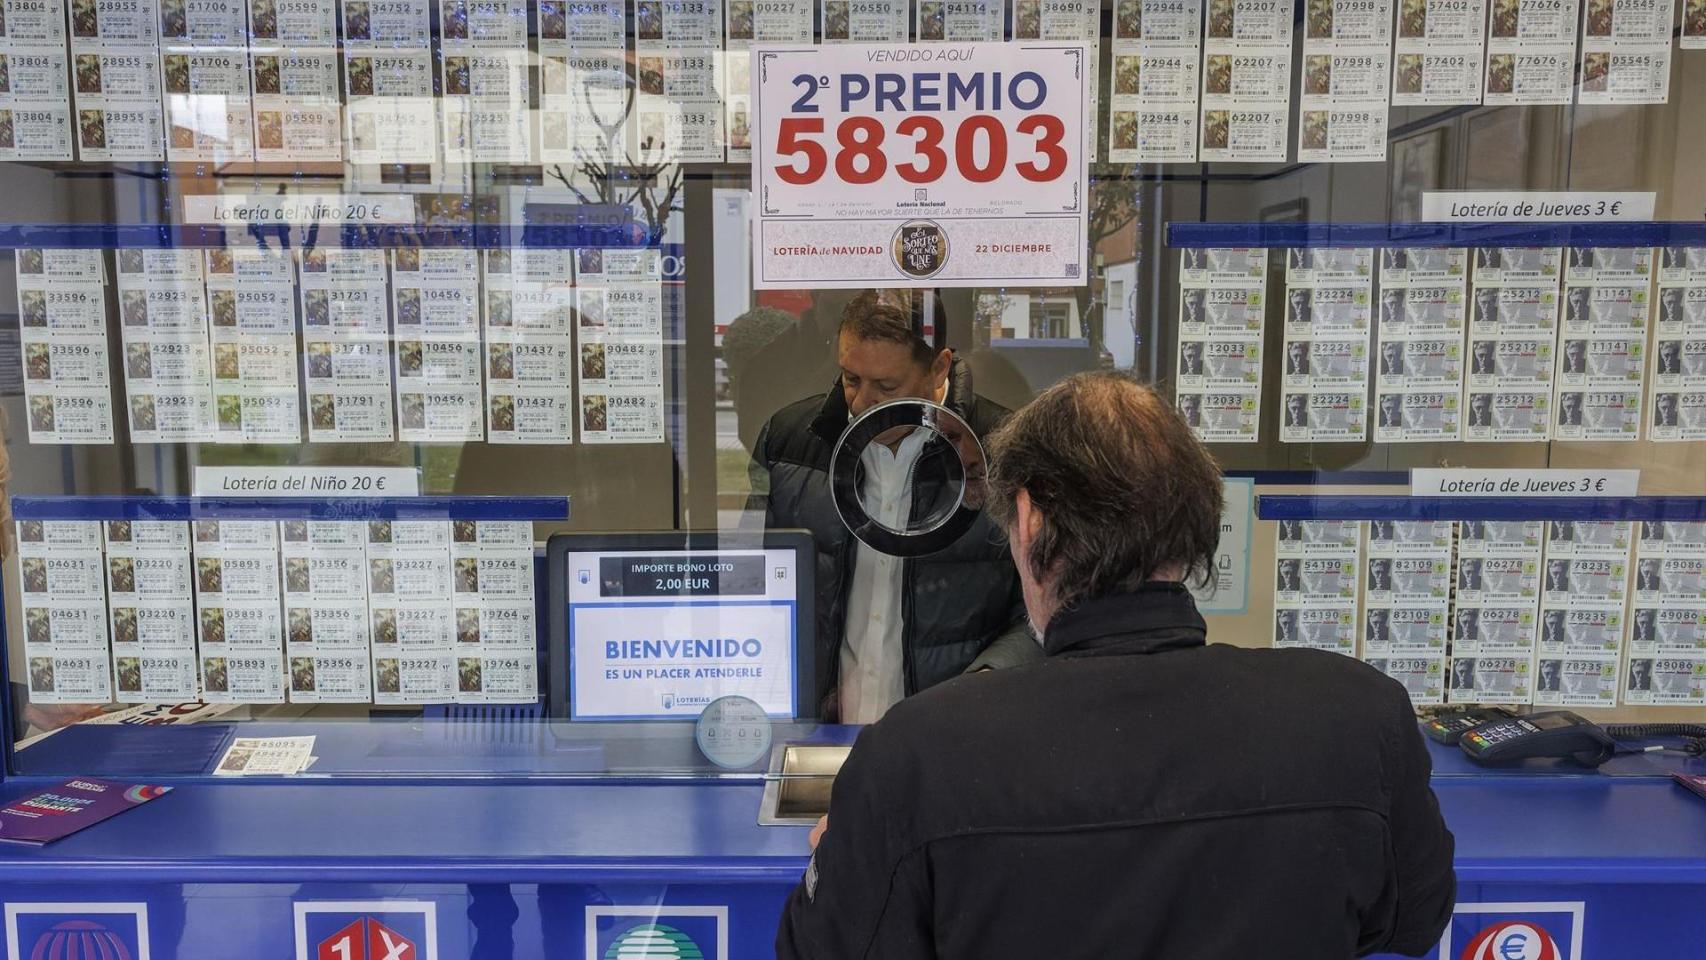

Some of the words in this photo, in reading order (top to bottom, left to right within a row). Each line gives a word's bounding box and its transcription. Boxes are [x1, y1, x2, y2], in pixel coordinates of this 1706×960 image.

[7, 1, 45, 12] 13804
[100, 1, 138, 11] 28955
[188, 2, 226, 12] 41706
[280, 2, 318, 12] 05599
[372, 3, 411, 13] 34752
[756, 3, 795, 13] 00227
[1145, 2, 1184, 10] 22944
[1237, 2, 1276, 10] 62207
[1336, 2, 1374, 10] 07998
[1428, 1, 1468, 10] 57402
[1522, 0, 1560, 9] 77676
[1616, 0, 1654, 8] 05545
[852, 3, 891, 14] 26550
[948, 3, 986, 14] 94114
[867, 50, 934, 62] VENDIDO
[937, 48, 975, 62] AQUÍ
[11, 58, 49, 67] 13804
[103, 58, 140, 67] 28955
[192, 58, 230, 67] 41706
[282, 58, 320, 68] 05599
[374, 58, 413, 68] 34752
[1143, 58, 1181, 66] 22944
[1234, 58, 1272, 66] 62207
[1334, 58, 1372, 66] 07998
[1426, 58, 1464, 66] 57402
[1518, 56, 1556, 64] 77676
[1612, 56, 1650, 64] 05545
[792, 73, 830, 112] 2º
[840, 71, 1048, 112] PREMIO
[15, 112, 52, 122] 13804
[107, 112, 144, 122] 28955
[1141, 114, 1179, 122] 22944
[1232, 114, 1270, 122] 62207
[1331, 114, 1369, 122] 07998
[774, 114, 1068, 185] 58303
[214, 205, 269, 220] Lotería
[275, 205, 300, 219] del
[304, 204, 342, 219] Niño
[346, 205, 367, 218] 20
[370, 205, 382, 218] €
[1451, 202, 1507, 217] Lotería
[1514, 201, 1534, 216] de
[1536, 201, 1590, 217] Jueves
[1595, 202, 1604, 215] 3
[1610, 201, 1622, 215] €
[774, 244, 818, 255] LOTERÍA
[992, 244, 1052, 252] DICIEMBRE
[49, 292, 86, 302] 33596
[238, 292, 275, 301] 95052
[424, 291, 460, 300] 10456
[1211, 290, 1247, 299] 12033
[1316, 290, 1353, 298] 32224
[1410, 290, 1446, 298] 39287
[1503, 290, 1540, 298] 25212
[1596, 290, 1632, 298] 11141
[52, 345, 90, 354] 33596
[241, 345, 278, 354] 95052
[426, 343, 462, 352] 10456
[516, 346, 553, 354] 01437
[608, 345, 644, 354] 90482
[1209, 344, 1245, 352] 12033
[1408, 343, 1445, 352] 39287
[1500, 343, 1536, 351] 25212
[56, 398, 93, 407] 33596
[337, 396, 374, 406] 31791
[428, 396, 464, 404] 10456
[517, 398, 554, 406] 01437
[608, 398, 646, 406] 90482
[1207, 396, 1242, 404] 12033
[1312, 396, 1349, 404] 32224
[1407, 396, 1444, 404] 39287
[223, 476, 277, 490] Lotería
[282, 476, 306, 490] del
[310, 476, 346, 490] Niño
[352, 476, 372, 490] 20
[376, 477, 386, 490] €
[1440, 478, 1496, 492] Lotería
[1500, 478, 1520, 492] de
[1523, 478, 1576, 492] Jueves
[1580, 478, 1590, 492] 3
[1595, 478, 1606, 490] €
[48, 560, 84, 568] 04631
[136, 560, 172, 568] 03220
[224, 560, 260, 568] 05893
[312, 560, 348, 568] 35356
[396, 561, 432, 569] 93227
[481, 560, 516, 568] 19764
[632, 564, 675, 573] IMPORTE
[677, 564, 706, 572] BONO
[708, 563, 734, 572] LOTO
[1304, 561, 1341, 569] 54190
[1396, 561, 1432, 569] 82109
[1486, 560, 1522, 568] 06278
[1574, 562, 1610, 570] 78235
[1664, 561, 1702, 569] 49086
[656, 579, 682, 590] 2,00
[686, 578, 710, 589] EUR
[52, 610, 88, 618] 04631
[139, 610, 176, 618] 03220
[227, 610, 262, 618] 05893
[314, 610, 350, 618] 35356
[483, 610, 518, 618] 19764
[1302, 612, 1339, 620] 54190
[1482, 611, 1520, 619] 06278
[1570, 613, 1606, 621] 78235
[1660, 612, 1698, 620] 49086
[606, 638, 762, 659] BIENVENIDO
[55, 660, 90, 668] 04631
[142, 660, 178, 668] 03220
[230, 660, 266, 668] 05893
[316, 660, 352, 668] 35356
[402, 660, 437, 668] 93227
[484, 660, 520, 668] 19764
[1566, 663, 1602, 671] 78235
[606, 670, 619, 680] ES
[623, 669, 643, 679] UN
[646, 668, 690, 678] PLACER
[694, 668, 762, 678] ATENDERLE
